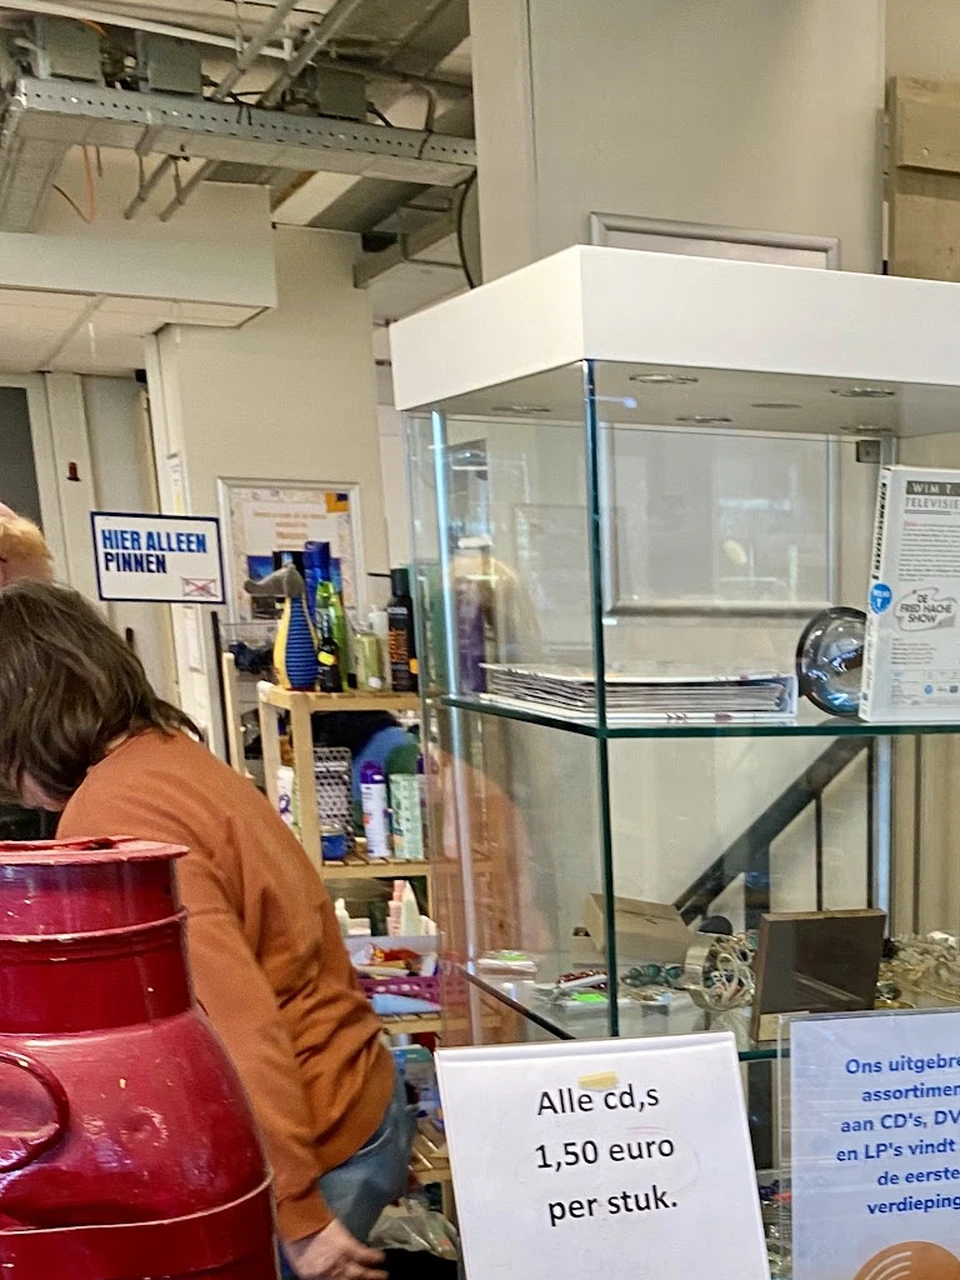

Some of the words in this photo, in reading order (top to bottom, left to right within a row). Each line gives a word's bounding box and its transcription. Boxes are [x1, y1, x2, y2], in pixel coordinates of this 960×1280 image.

[912, 482, 940, 495] WIM
[101, 529, 142, 551] HIER
[146, 531, 207, 553] ALLEEN
[104, 552, 167, 574] PINNEN
[900, 603, 922, 613] FRED
[917, 594, 929, 603] DE
[907, 614, 938, 623] SHOW
[845, 1058, 883, 1075] Ons
[537, 1087, 595, 1117] Alle
[603, 1082, 661, 1113] cd,s
[840, 1119, 875, 1133] aan
[880, 1112, 929, 1130] CD's,
[534, 1140, 599, 1173] 1,50
[608, 1137, 675, 1163] euro
[836, 1149, 859, 1162] en
[864, 1142, 904, 1160] LP's
[907, 1137, 956, 1156] vindt
[877, 1170, 900, 1186] de
[547, 1197, 599, 1228] per
[606, 1184, 678, 1215] stuk.
